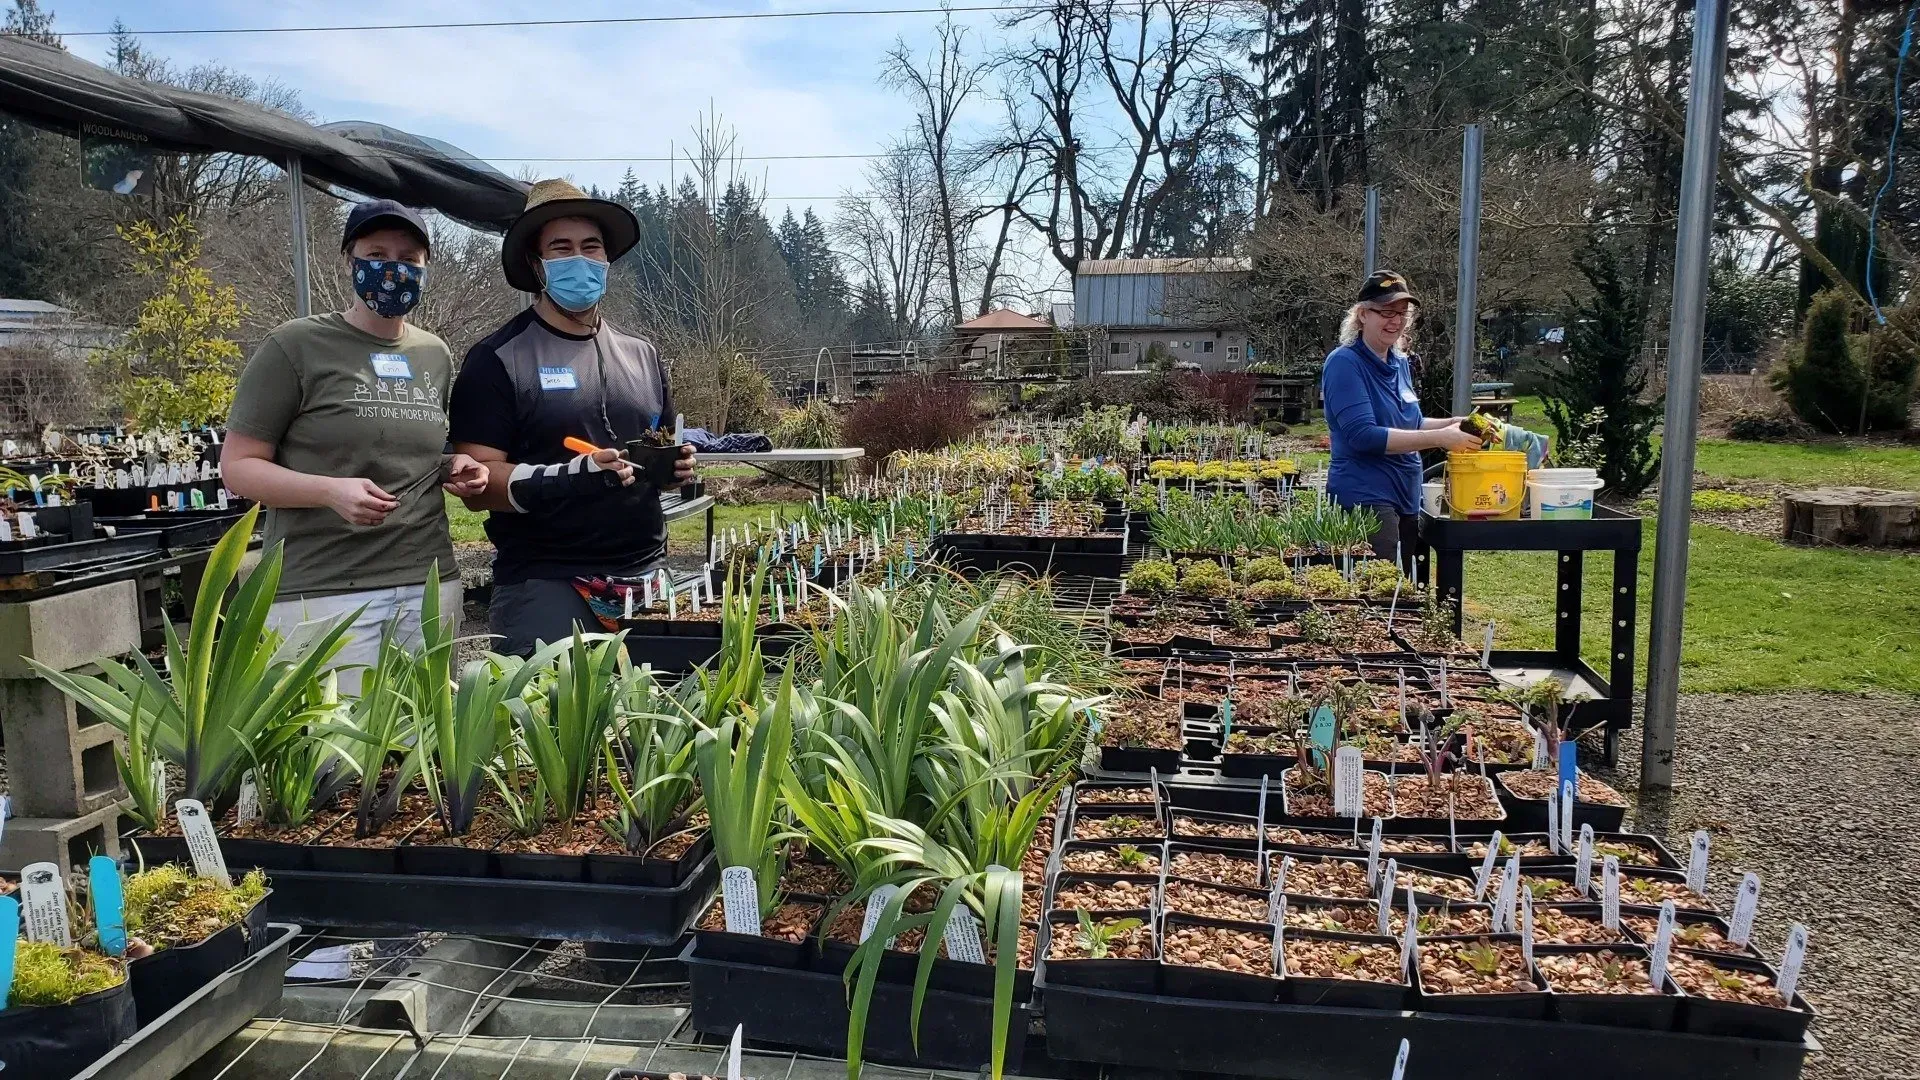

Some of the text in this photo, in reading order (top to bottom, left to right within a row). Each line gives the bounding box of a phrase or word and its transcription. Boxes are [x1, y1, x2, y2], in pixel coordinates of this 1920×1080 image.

[82, 122, 149, 142] WOODLANDERS
[355, 406, 379, 418] JUST
[380, 407, 400, 419] ONE
[400, 408, 423, 421] MORE
[725, 869, 748, 880] 12-23
[52, 892, 60, 906] Secret
[53, 907, 63, 926] Garden
